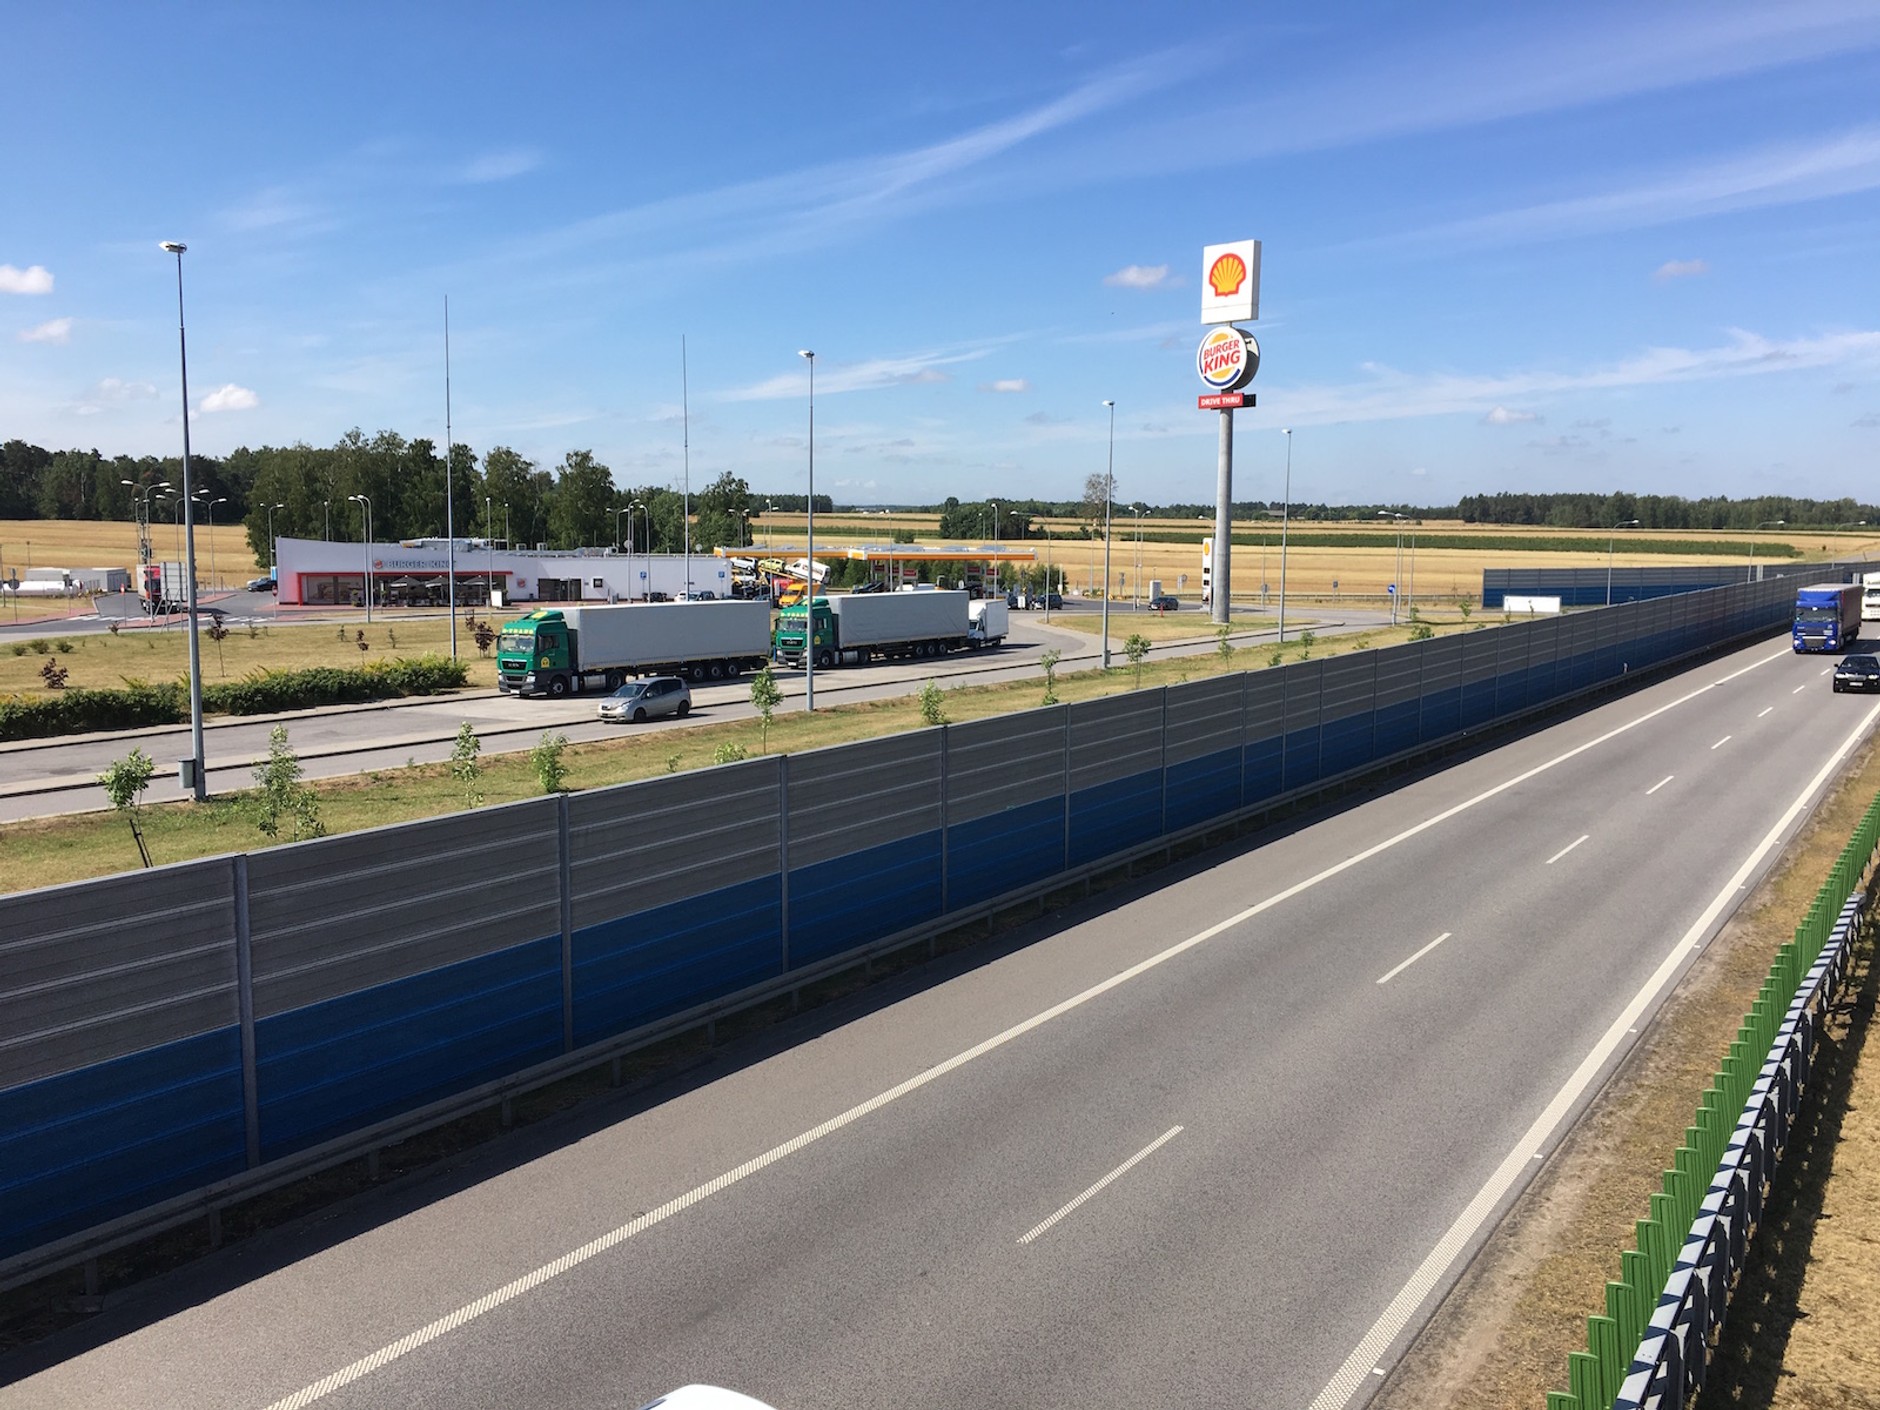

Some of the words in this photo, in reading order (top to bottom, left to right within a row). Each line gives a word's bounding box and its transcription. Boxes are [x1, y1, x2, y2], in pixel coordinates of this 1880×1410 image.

[1203, 339, 1240, 360] BURGER
[1203, 350, 1241, 375] KING
[1201, 397, 1221, 406] DRIVE
[1221, 396, 1240, 404] THRU
[387, 560, 426, 569] BURGER
